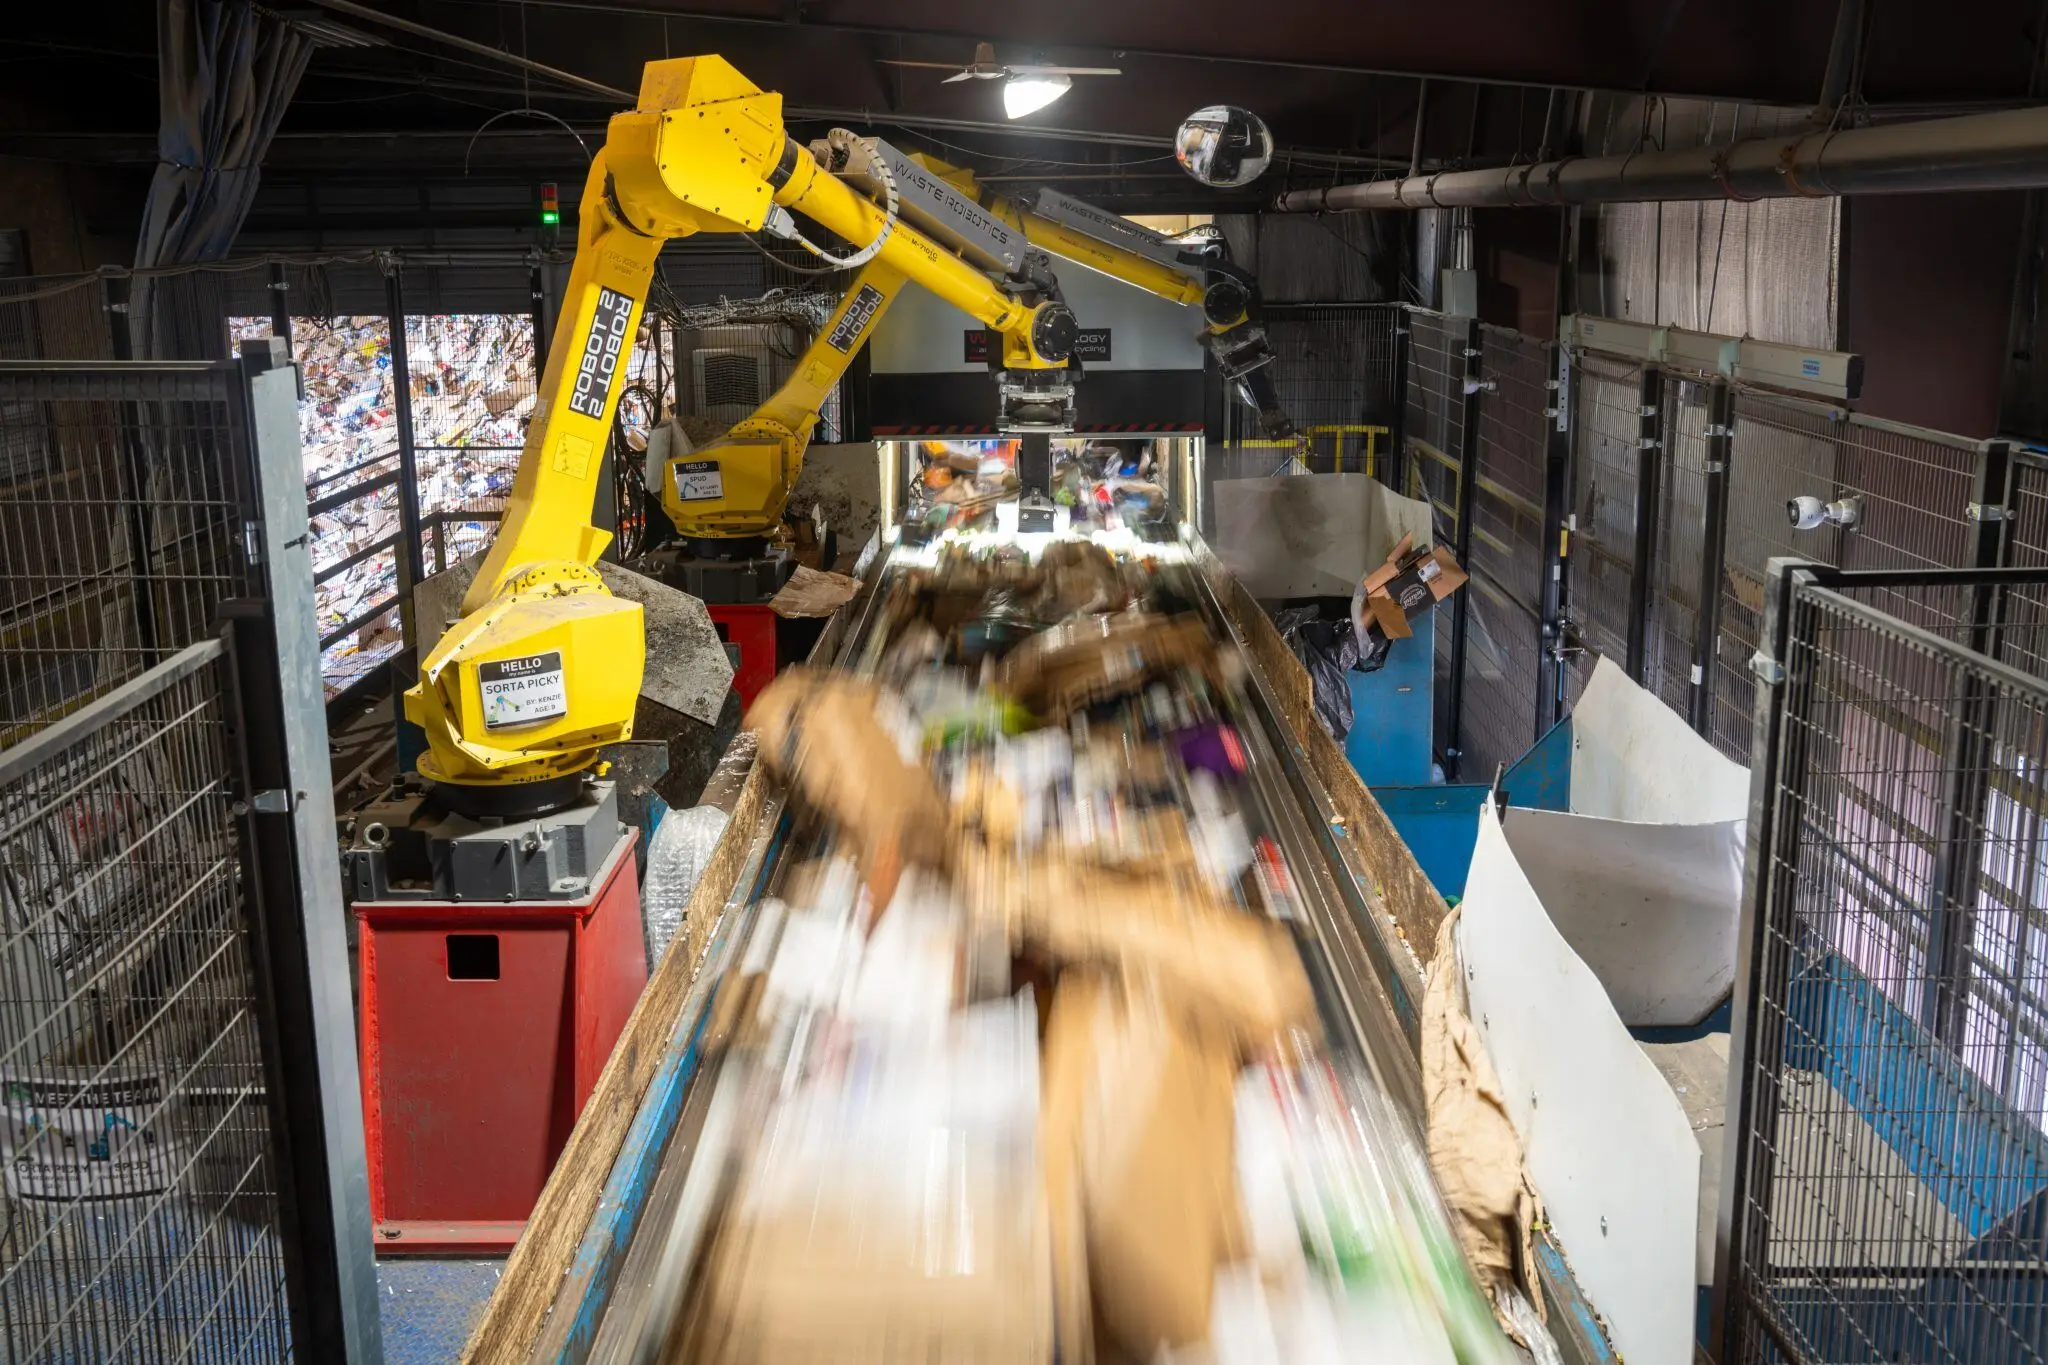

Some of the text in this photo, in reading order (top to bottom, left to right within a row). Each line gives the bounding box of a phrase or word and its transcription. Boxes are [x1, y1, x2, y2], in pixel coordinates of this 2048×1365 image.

[895, 160, 1009, 245] WASTE ROBOTICS
[1060, 198, 1163, 247] WASTE ROBOTICS
[827, 294, 865, 346] ROBOT
[846, 292, 884, 345] ROBOT
[571, 289, 616, 412] ROBOT 2
[597, 295, 633, 394] ROBOT
[588, 397, 605, 418] 2
[685, 462, 708, 470] HELLO
[500, 657, 542, 673] HELLO
[486, 674, 560, 695] SORTA PICKY
[538, 693, 562, 703] KENZIE
[112, 1086, 159, 1104] TEAM
